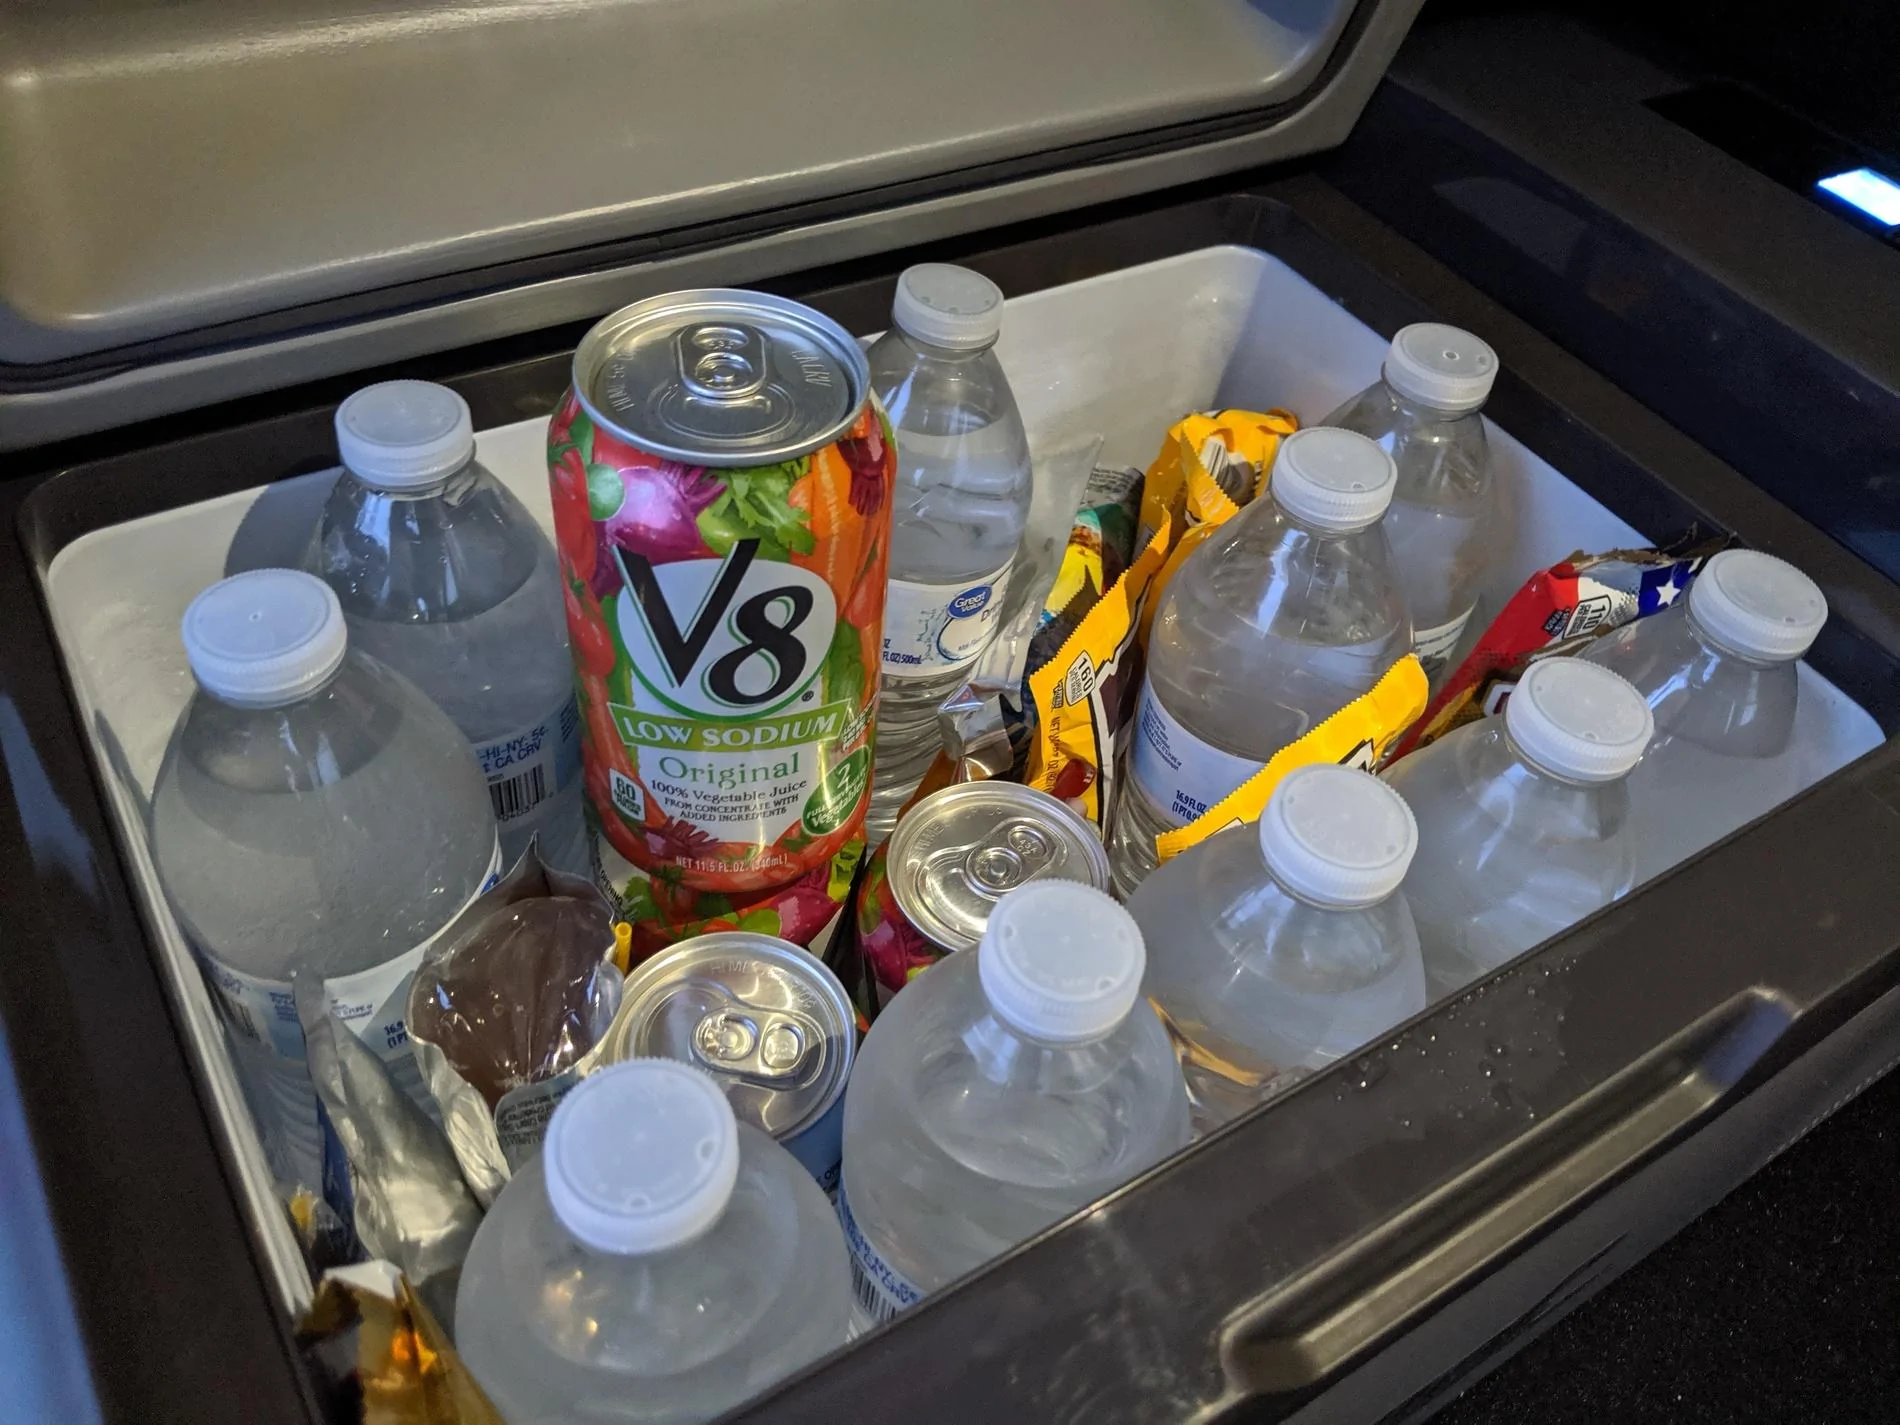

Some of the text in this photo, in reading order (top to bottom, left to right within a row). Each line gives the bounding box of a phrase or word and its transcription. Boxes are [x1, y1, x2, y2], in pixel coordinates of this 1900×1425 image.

[611, 537, 815, 707] V8
[1078, 657, 1094, 692] 160
[624, 716, 692, 746] LOW
[702, 712, 836, 748] SODIUM
[659, 751, 800, 790] Original
[651, 780, 689, 799] 100%
[693, 790, 767, 804] Vegetable
[769, 779, 808, 797] Juice
[664, 794, 800, 814] FROM CONCENTRATE WITH
[680, 810, 717, 822] ADDED
[676, 856, 694, 870] NET
